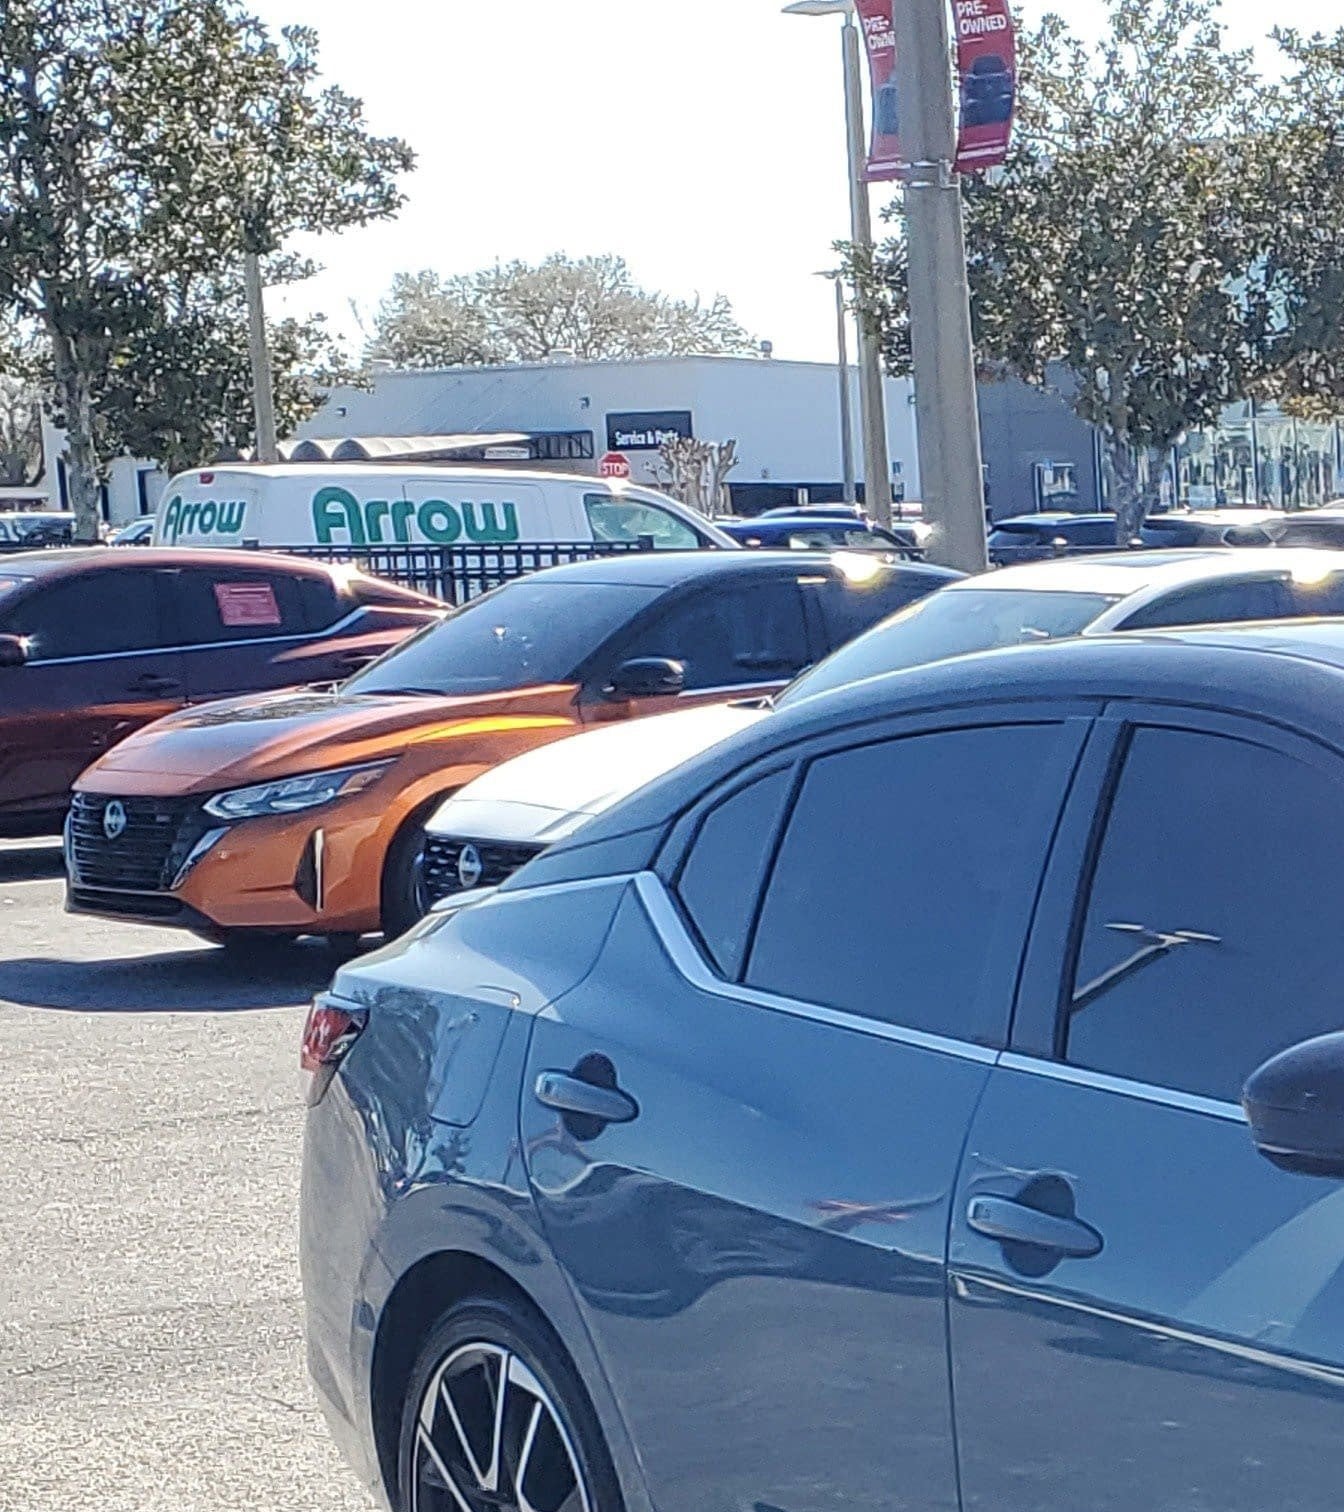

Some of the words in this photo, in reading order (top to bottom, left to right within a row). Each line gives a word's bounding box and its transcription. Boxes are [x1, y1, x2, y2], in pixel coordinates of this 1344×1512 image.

[956, 1, 988, 17] PRE-
[864, 15, 889, 35] PRE-
[959, 14, 1006, 35] OWNED
[600, 462, 629, 475] STOP
[162, 495, 246, 546] Arrow
[312, 486, 520, 545] Arrow
